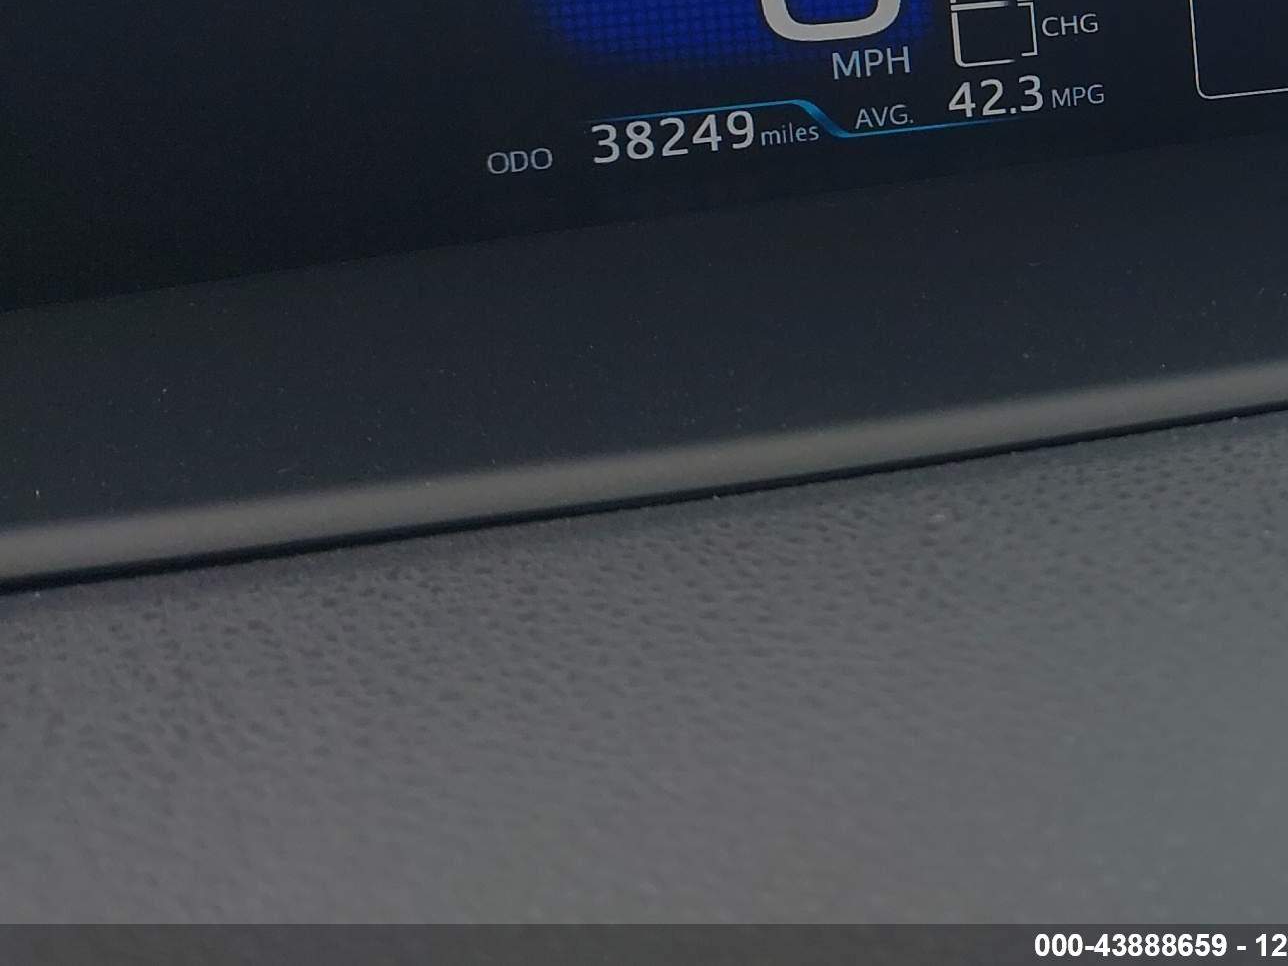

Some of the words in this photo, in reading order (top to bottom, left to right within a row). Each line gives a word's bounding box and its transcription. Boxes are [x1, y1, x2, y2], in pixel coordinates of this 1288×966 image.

[1041, 13, 1099, 36] CHG
[832, 46, 911, 80] MPH
[856, 105, 914, 129] AVG.
[949, 75, 1044, 118] 42.3
[1051, 84, 1105, 109] MPG
[487, 148, 553, 174] ODO
[592, 109, 756, 164] 38249
[760, 122, 820, 146] miles
